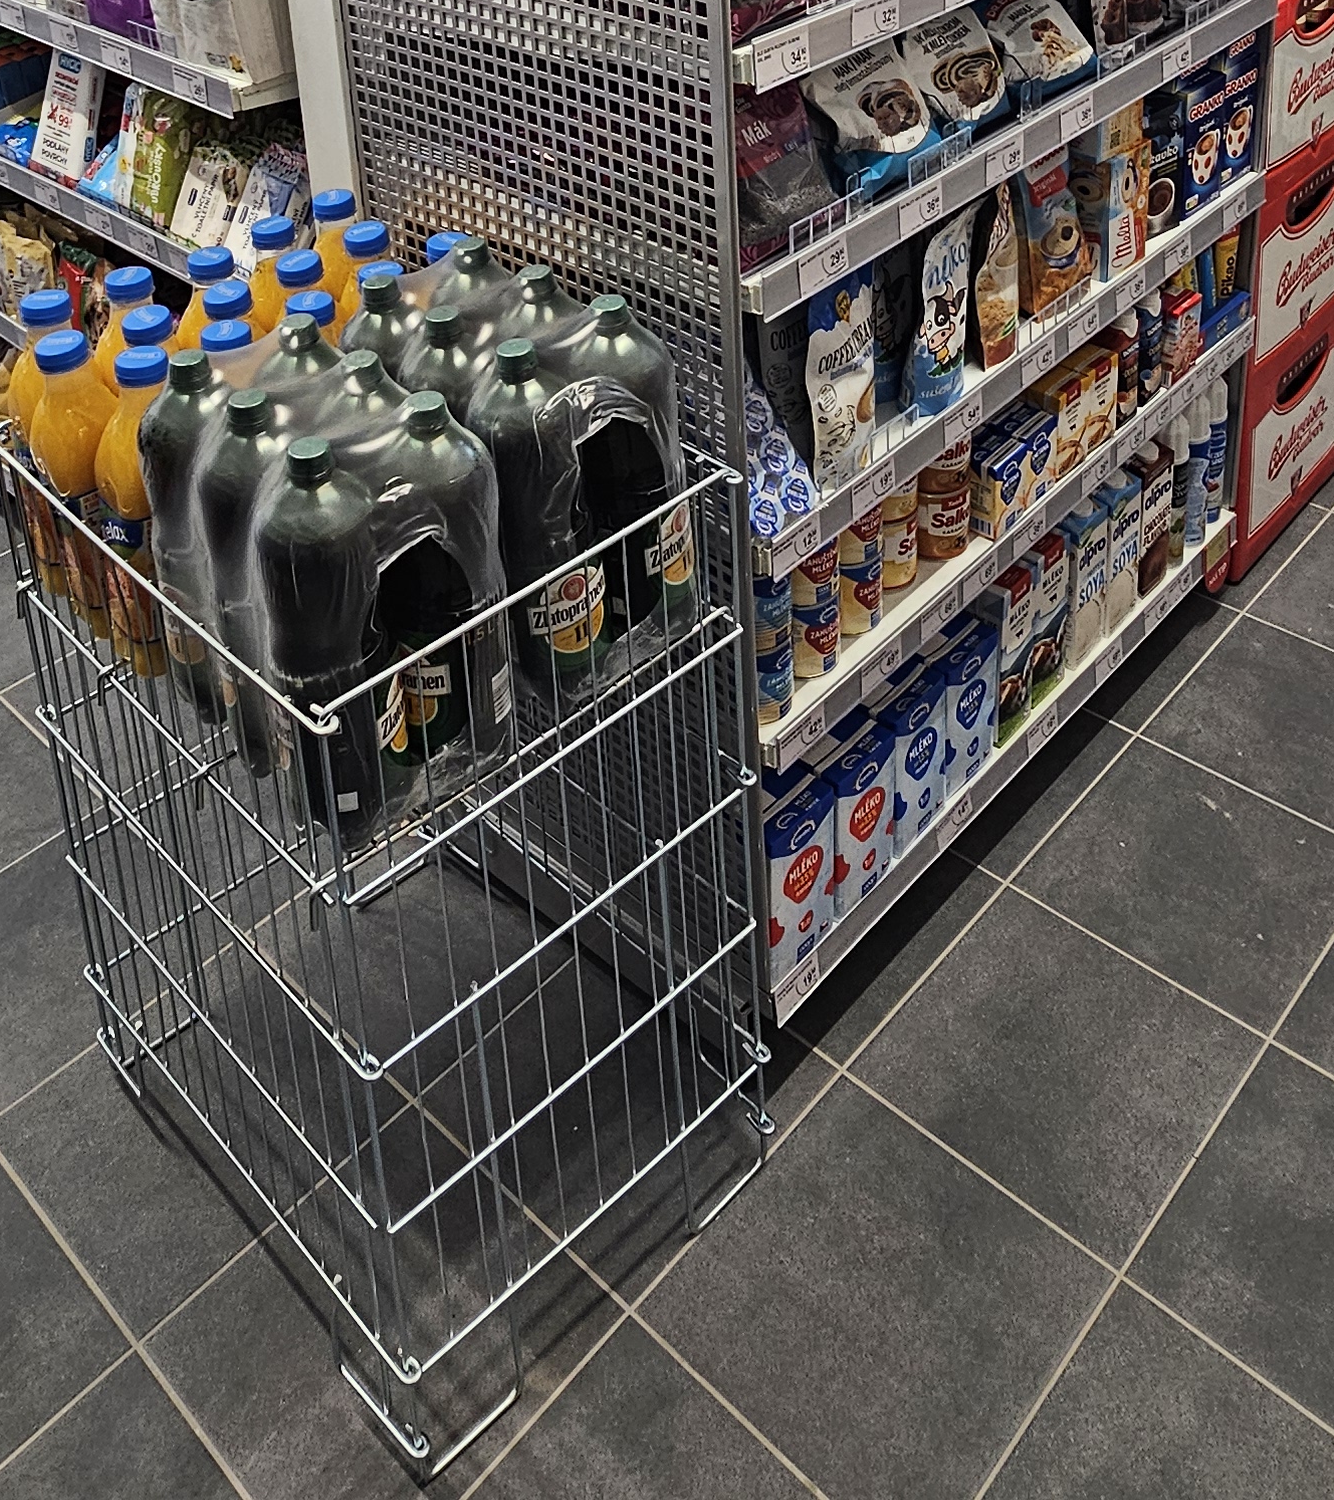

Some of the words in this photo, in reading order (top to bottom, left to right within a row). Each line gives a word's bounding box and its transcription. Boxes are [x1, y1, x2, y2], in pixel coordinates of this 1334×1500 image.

[1223, 68, 1259, 98] GRANKO
[1188, 91, 1226, 123] GRANKO
[740, 119, 773, 147] Mák
[1111, 214, 1131, 270] Melta
[818, 344, 856, 376] COFFEE
[1267, 395, 1329, 483] Budweiser
[1144, 478, 1173, 511] alpro
[1112, 508, 1141, 542] alpro
[1078, 535, 1107, 571] alpro
[1112, 539, 1139, 579] SOYA
[1079, 568, 1106, 608] SOYA
[959, 683, 984, 712] MLÉKO
[908, 730, 934, 761] MLÉKO
[852, 790, 882, 824] MLÉKO
[788, 849, 819, 883] MLÉKO
